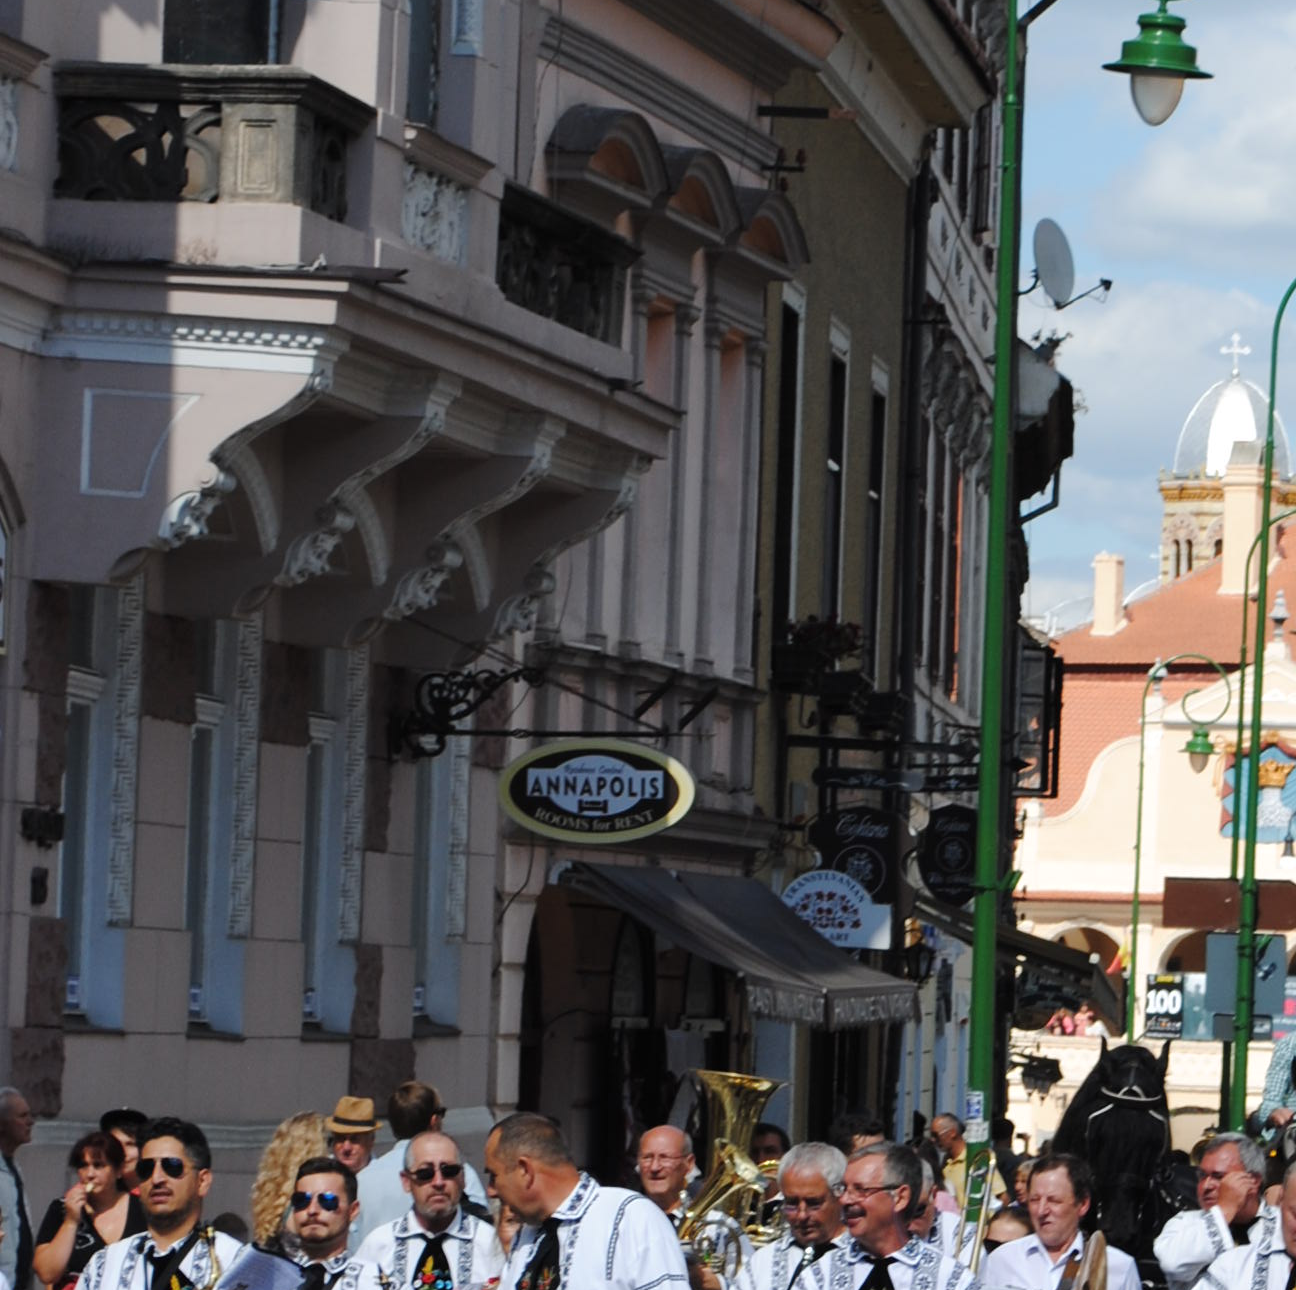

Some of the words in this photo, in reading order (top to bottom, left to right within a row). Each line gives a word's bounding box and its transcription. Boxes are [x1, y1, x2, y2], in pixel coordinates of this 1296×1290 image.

[530, 776, 660, 798] ANNAPOLIS
[534, 807, 589, 831] ROOMS
[591, 819, 610, 831] for
[614, 809, 655, 830] RENT
[785, 870, 866, 904] TRANSYLVANIAN
[1146, 989, 1182, 1014] 100
